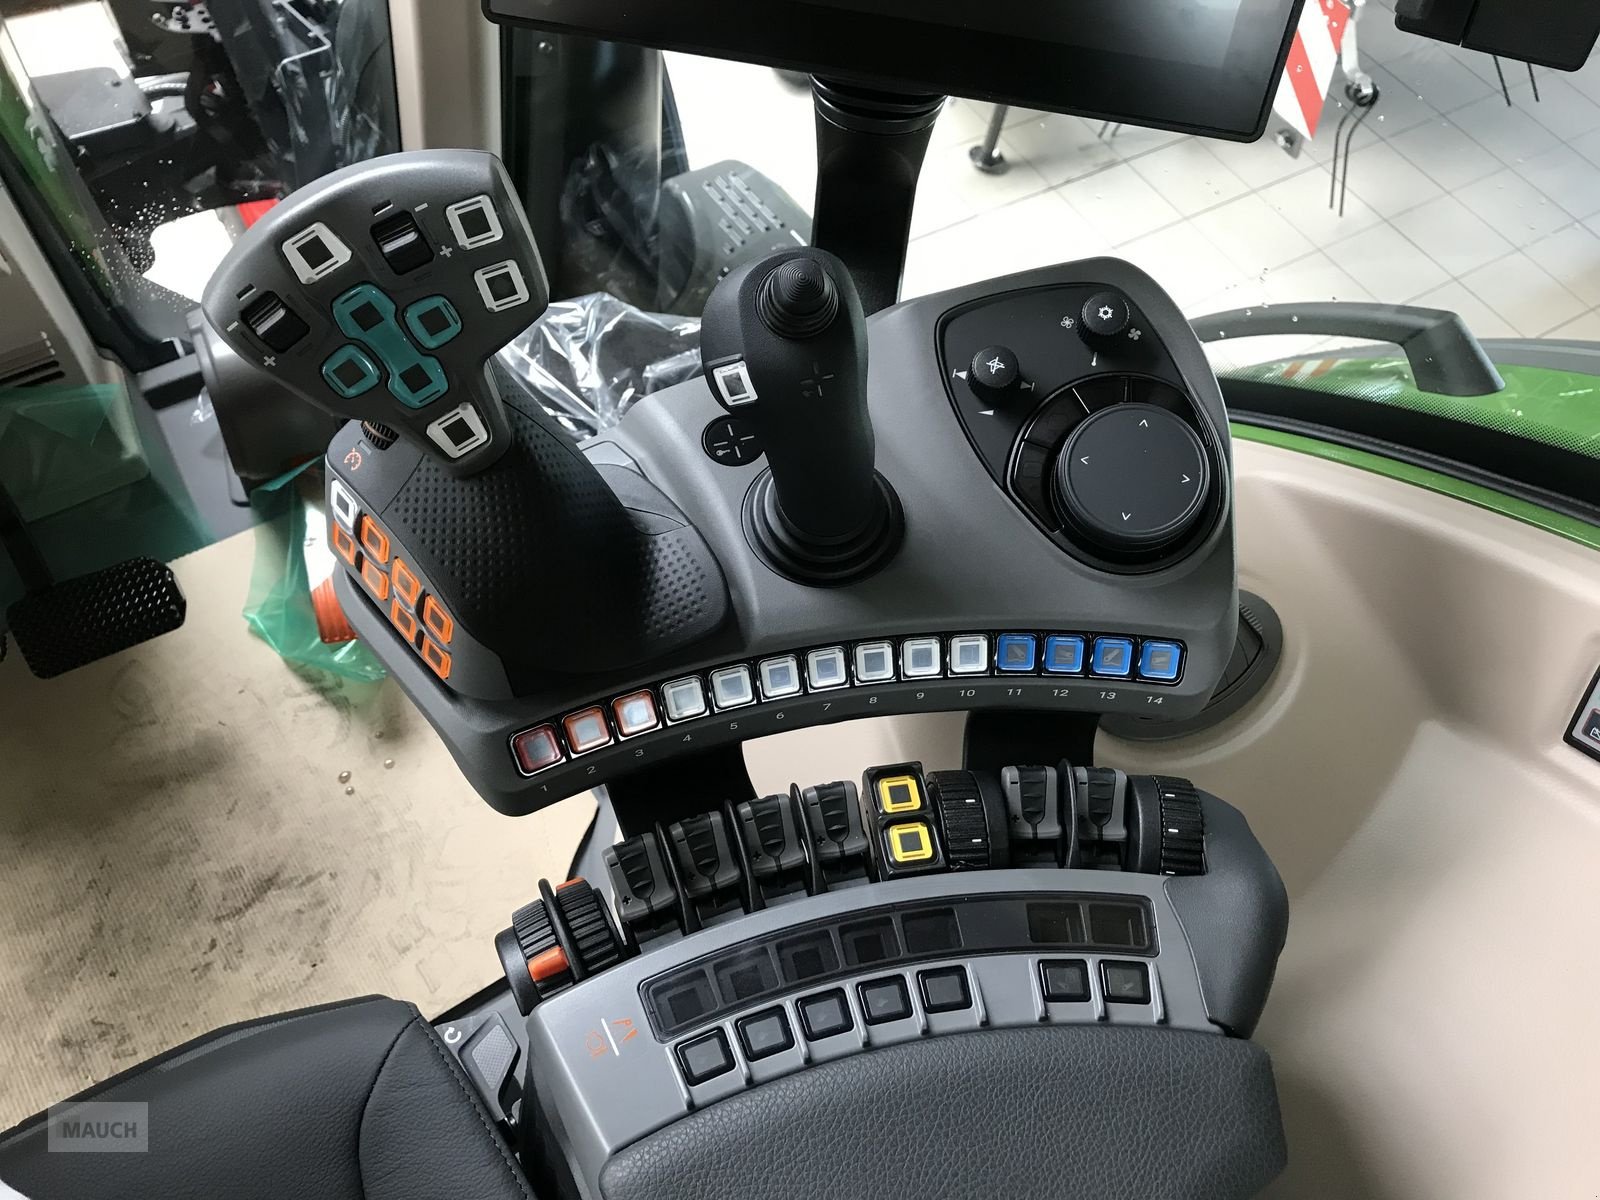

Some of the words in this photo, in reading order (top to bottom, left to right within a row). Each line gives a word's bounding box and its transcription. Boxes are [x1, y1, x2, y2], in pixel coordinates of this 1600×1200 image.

[541, 784, 547, 792] 1
[587, 766, 596, 775] 2
[635, 749, 644, 757] 3
[683, 734, 692, 742] 4
[730, 722, 738, 730] 5
[776, 711, 785, 720] 6
[823, 703, 832, 711] 7
[869, 696, 878, 704] 8
[916, 692, 925, 700] 9
[959, 689, 976, 697] 10
[1007, 688, 1022, 696] 11
[1052, 689, 1069, 697] 12
[1100, 691, 1117, 700] 13
[1146, 696, 1163, 705] 14
